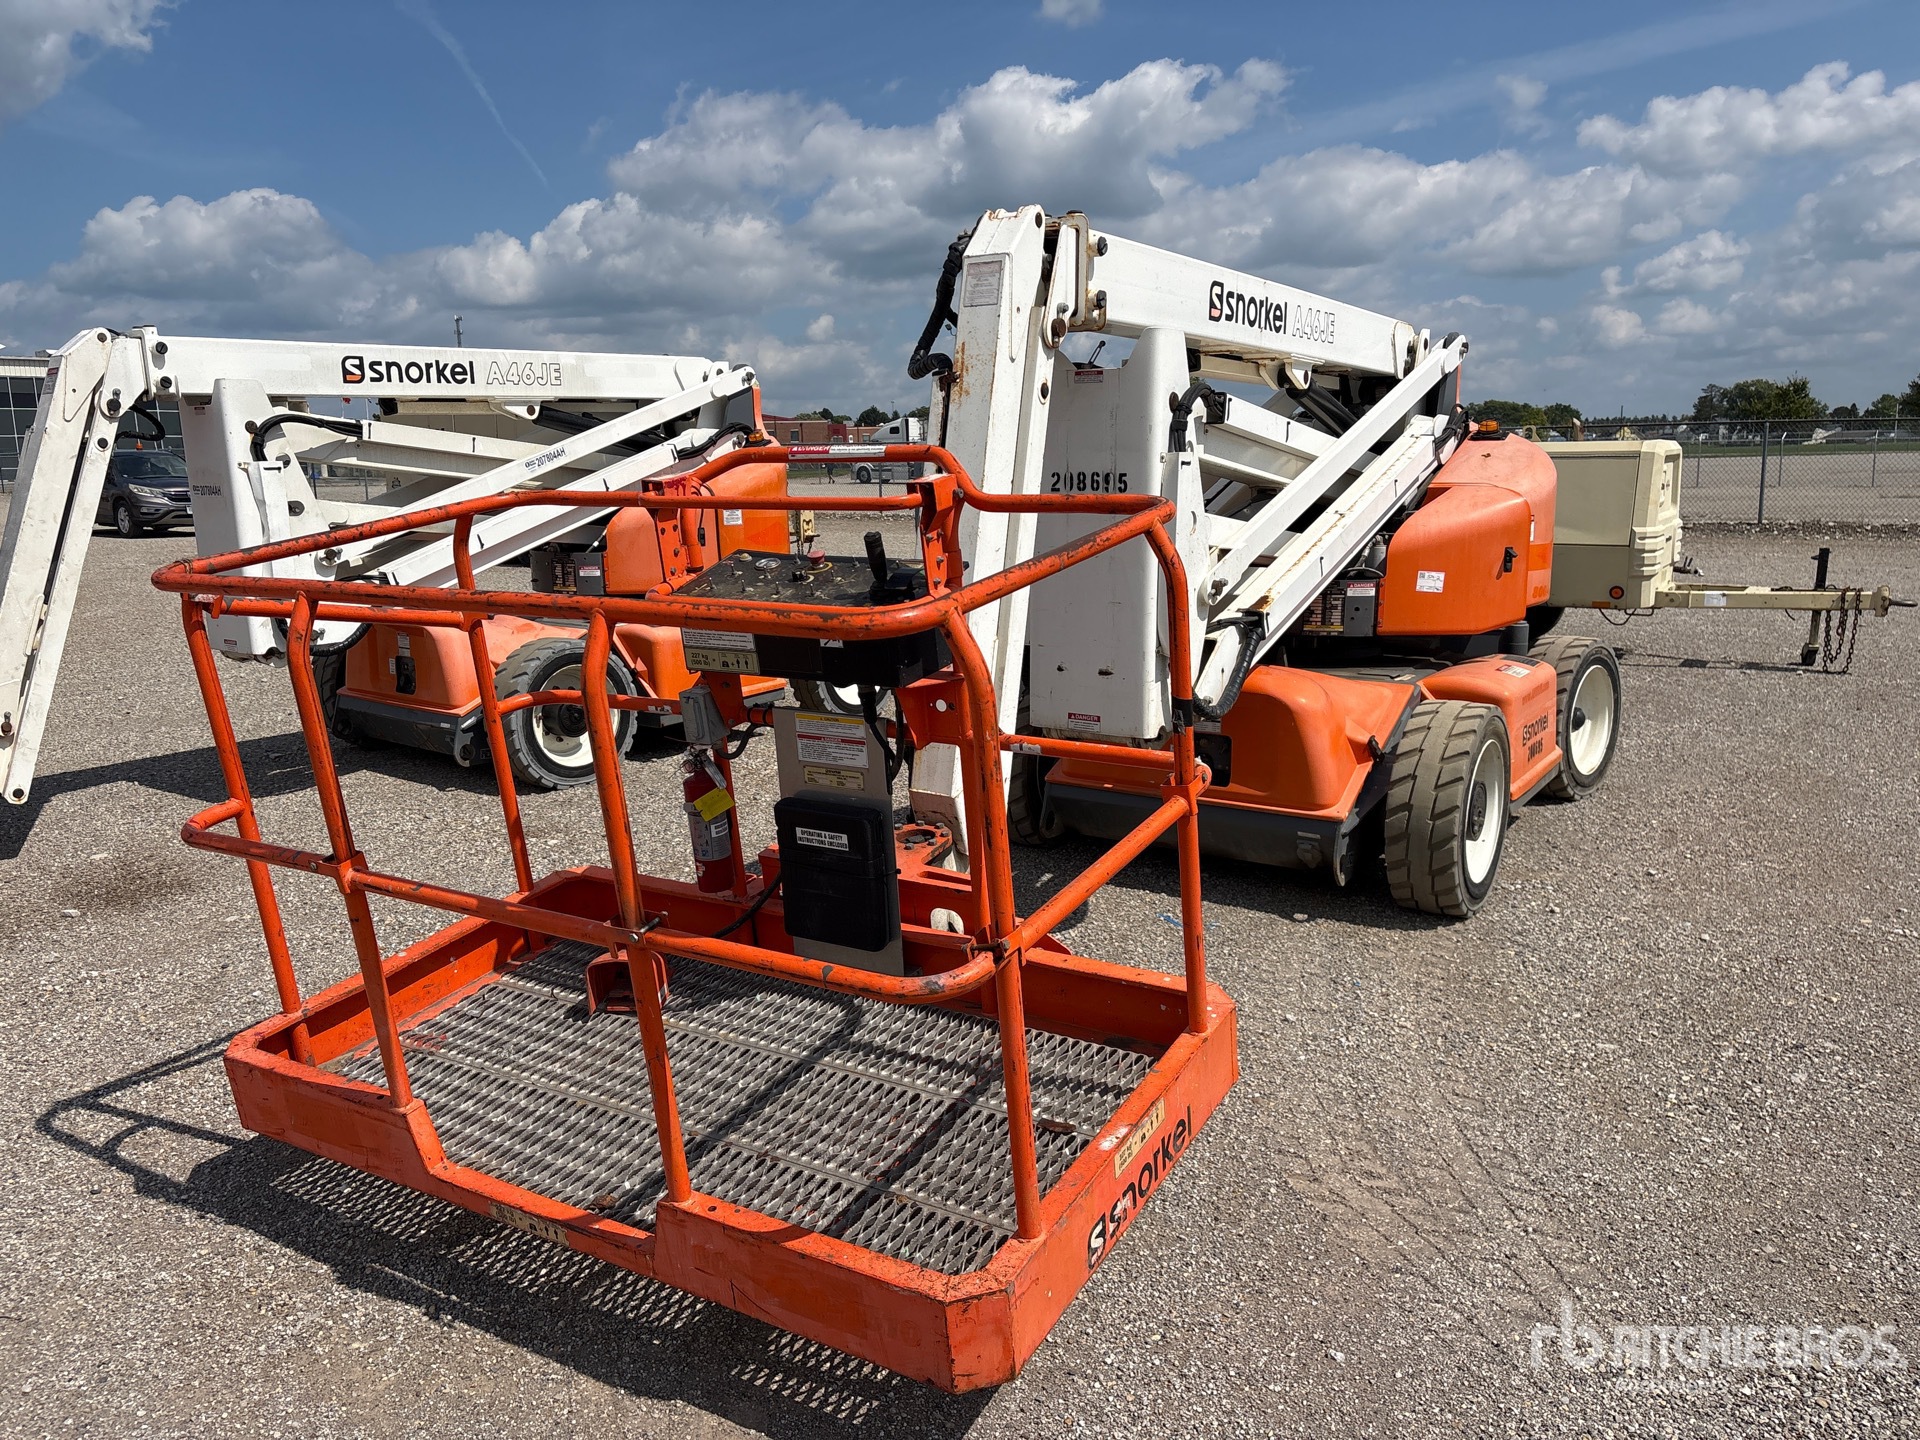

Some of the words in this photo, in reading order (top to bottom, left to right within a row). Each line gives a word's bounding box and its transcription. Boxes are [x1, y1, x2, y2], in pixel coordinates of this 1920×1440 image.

[1225, 290, 1288, 335] snorkel
[1292, 304, 1336, 344] A46JE
[368, 360, 476, 385] snorkel
[486, 361, 562, 387] A46JE
[1050, 471, 1128, 494] 208695
[1075, 714, 1099, 722] DANGER
[1527, 711, 1549, 742] snorkel
[797, 836, 827, 846] INSTRUCTIONS
[827, 840, 848, 850] ENCLOSED
[800, 829, 823, 839] OPERATING
[828, 833, 843, 842] SAFETY
[1109, 1103, 1193, 1241] snorkel
